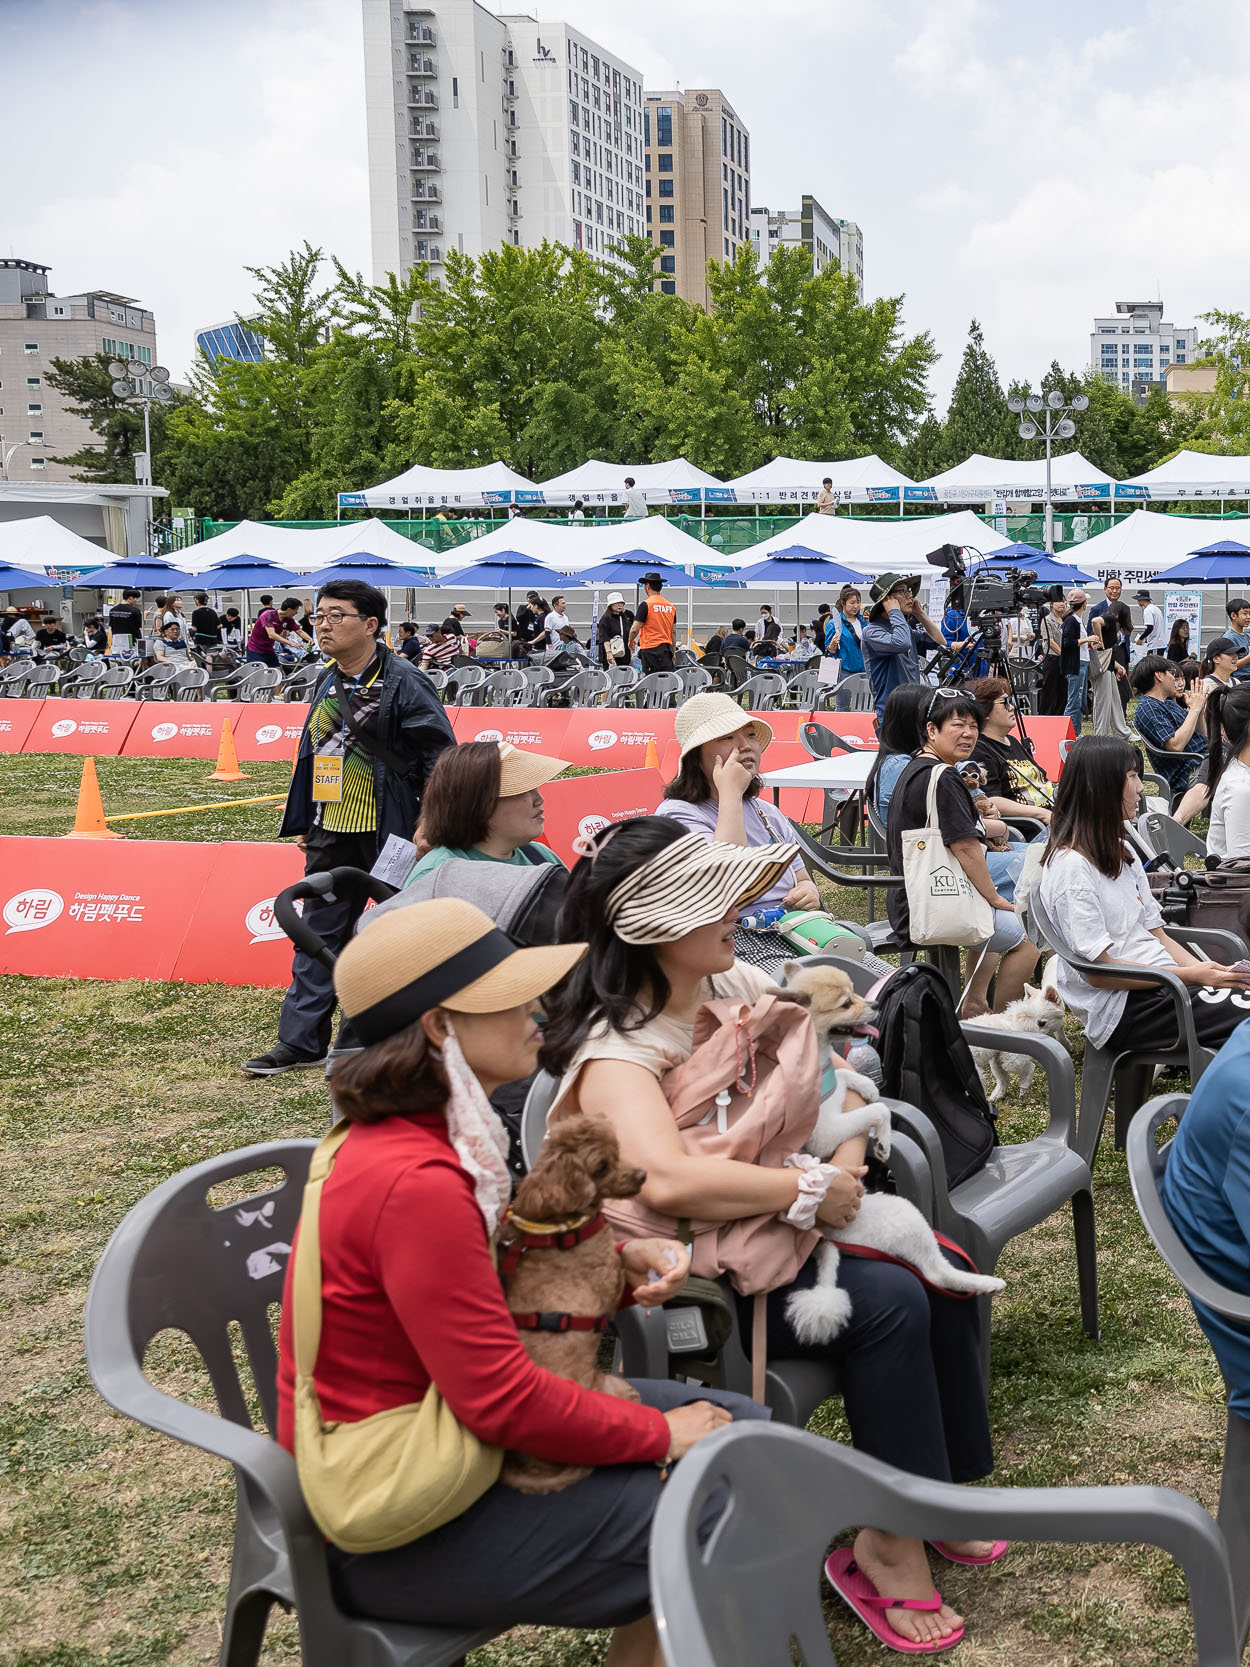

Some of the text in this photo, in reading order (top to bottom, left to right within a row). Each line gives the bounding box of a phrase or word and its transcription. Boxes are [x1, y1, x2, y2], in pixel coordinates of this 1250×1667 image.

[653, 604, 673, 613] STAFF
[315, 775, 340, 784] STAFF
[934, 875, 955, 887] KU
[74, 892, 141, 902] Design Happy Dance
[16, 898, 52, 920] 하림
[69, 902, 145, 923] 하림펫푸드
